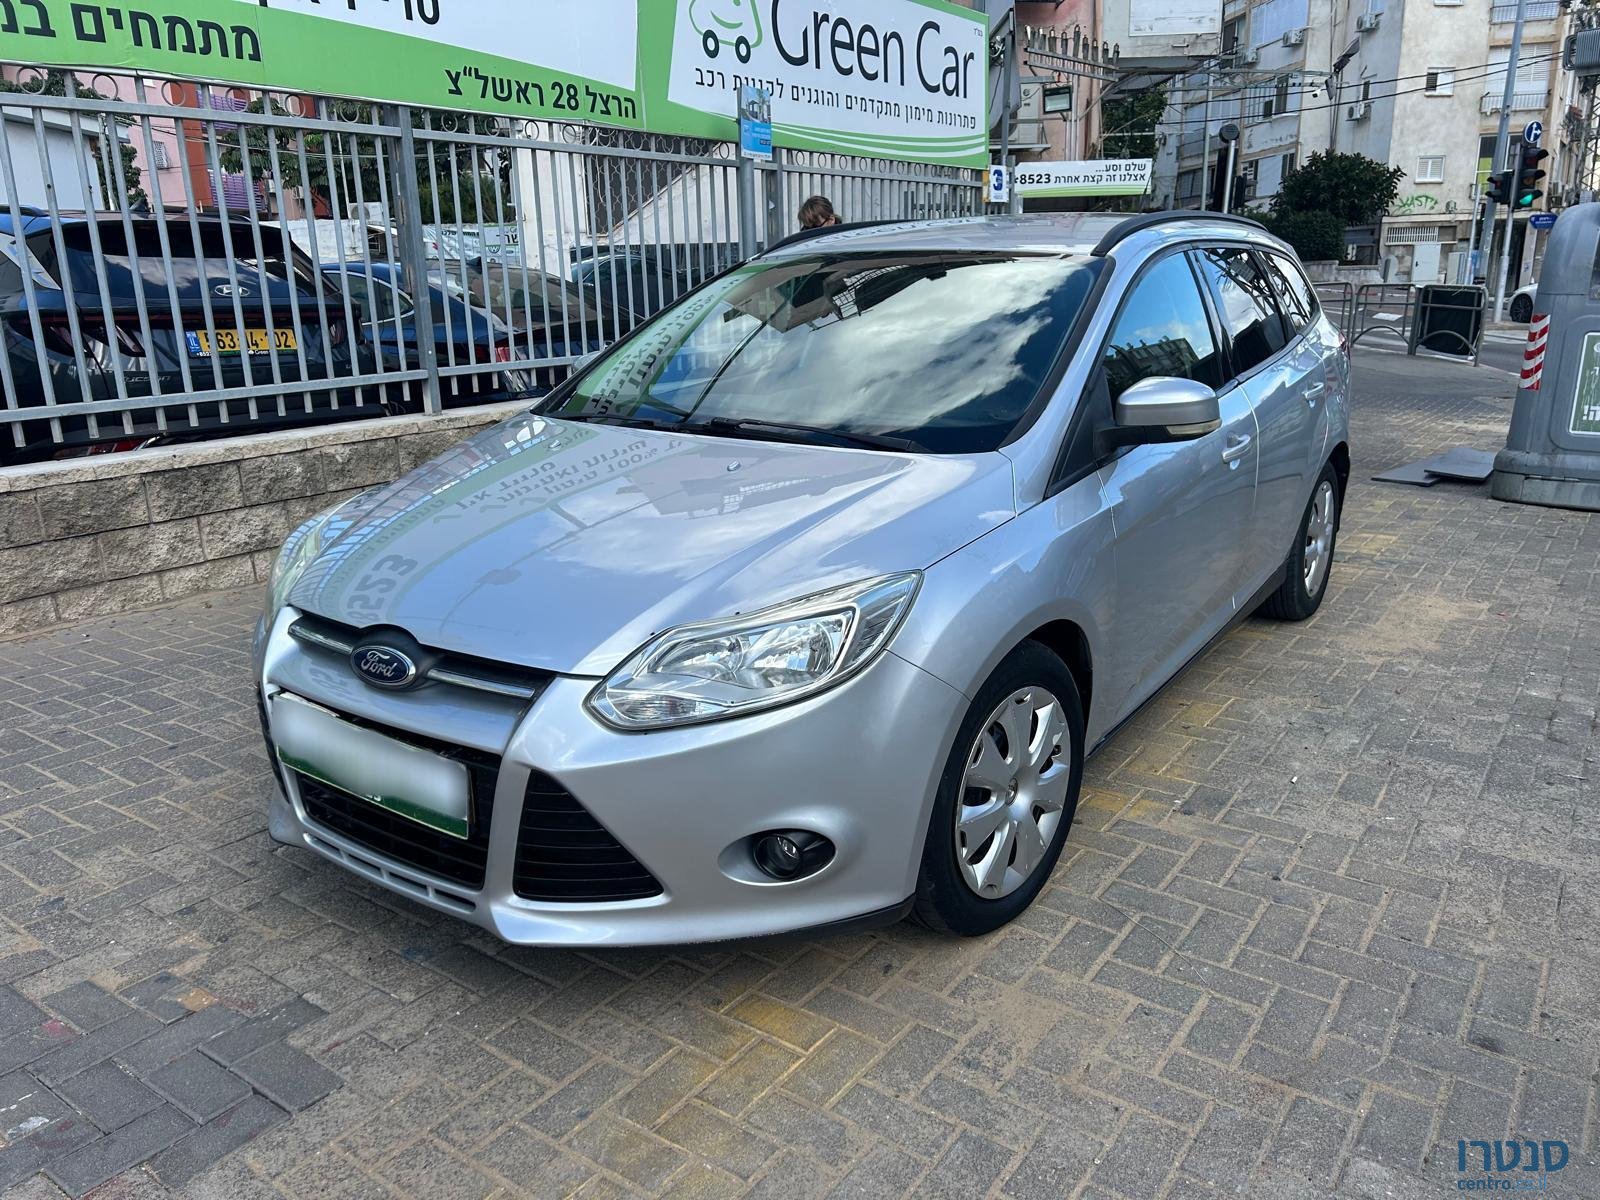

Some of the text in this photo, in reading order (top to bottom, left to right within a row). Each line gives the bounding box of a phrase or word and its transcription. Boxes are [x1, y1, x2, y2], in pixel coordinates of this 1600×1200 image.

[70, 2, 262, 62] מתמחים
[771, 0, 975, 99] Green Car
[695, 67, 725, 90] רכב
[550, 81, 580, 111] 28
[585, 85, 637, 119] הרצל
[791, 85, 840, 108] והוגנים
[845, 94, 900, 119] מתקדמים
[905, 104, 933, 123] מימון
[937, 110, 976, 129] פתרונות
[1105, 174, 1117, 182] זה
[1119, 172, 1146, 182] אצלנו
[1124, 162, 1147, 172] שלם
[1053, 175, 1080, 184] אחרת
[1082, 174, 1103, 184] קצת
[360, 649, 398, 678] Ford
